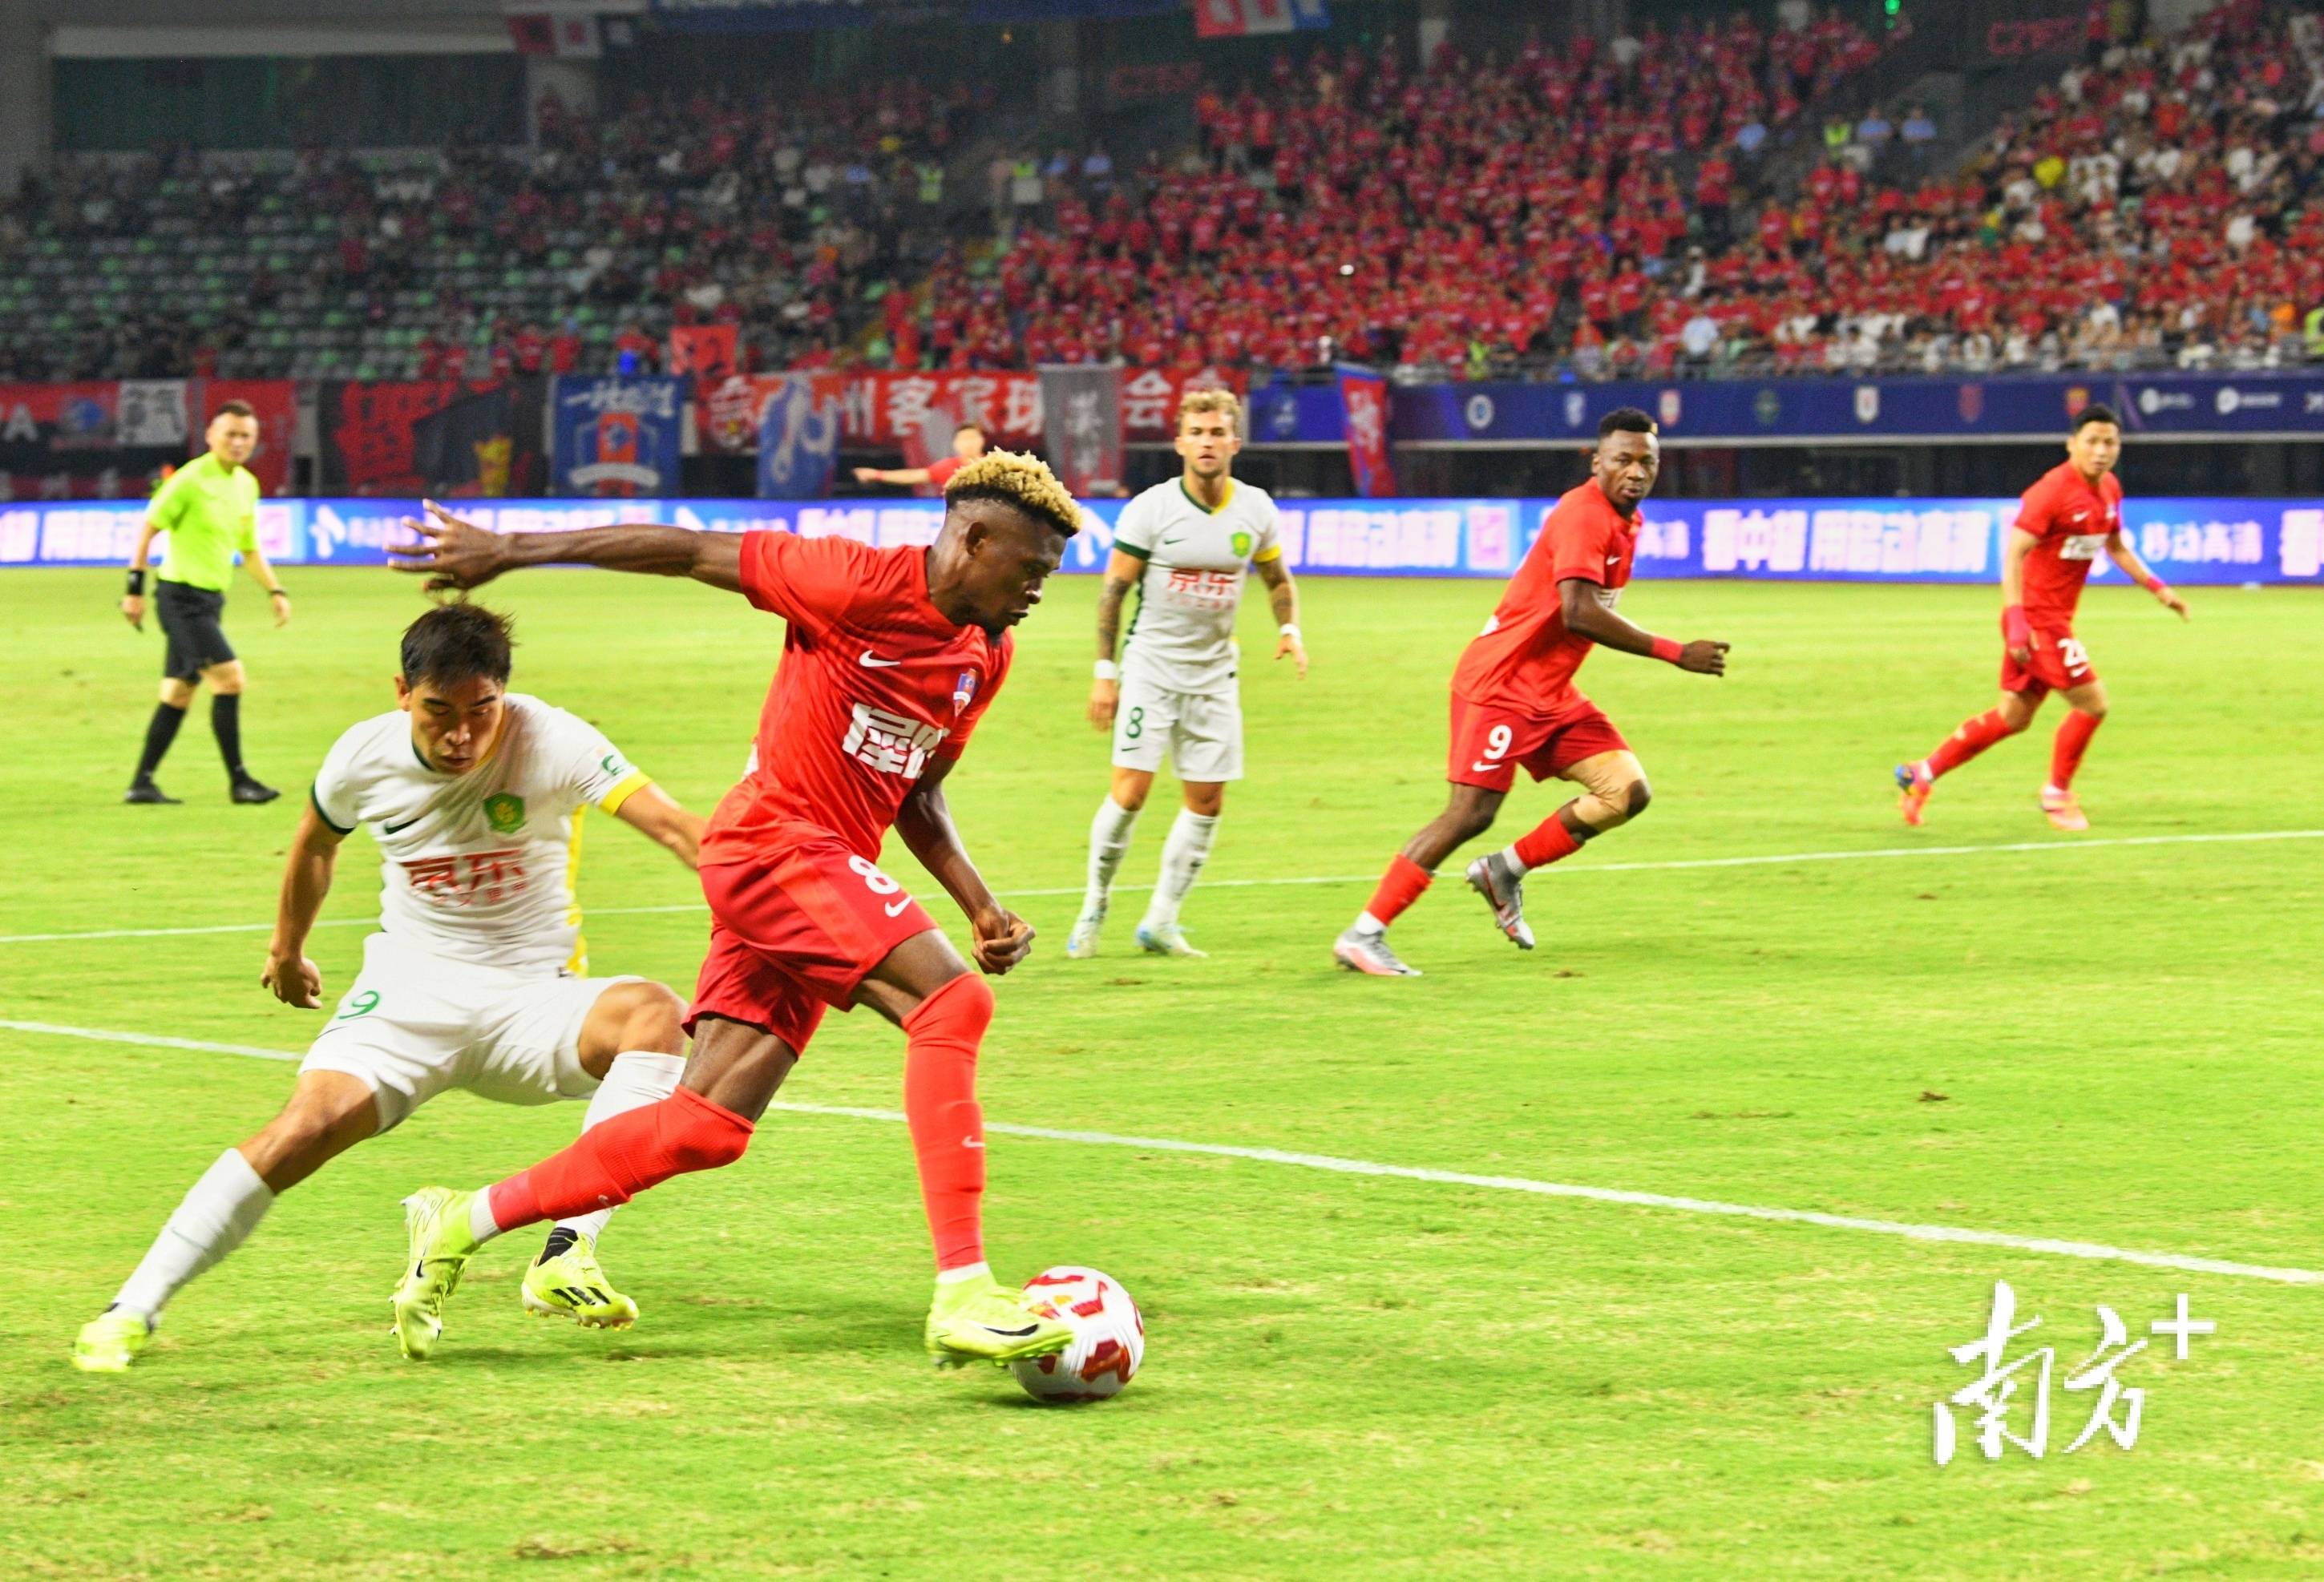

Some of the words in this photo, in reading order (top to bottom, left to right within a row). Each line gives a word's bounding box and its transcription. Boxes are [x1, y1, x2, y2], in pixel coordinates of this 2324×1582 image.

[1126, 706, 1144, 739] 8
[1483, 724, 1513, 760] 9
[847, 854, 900, 895] 8
[338, 990, 379, 1019] 9
